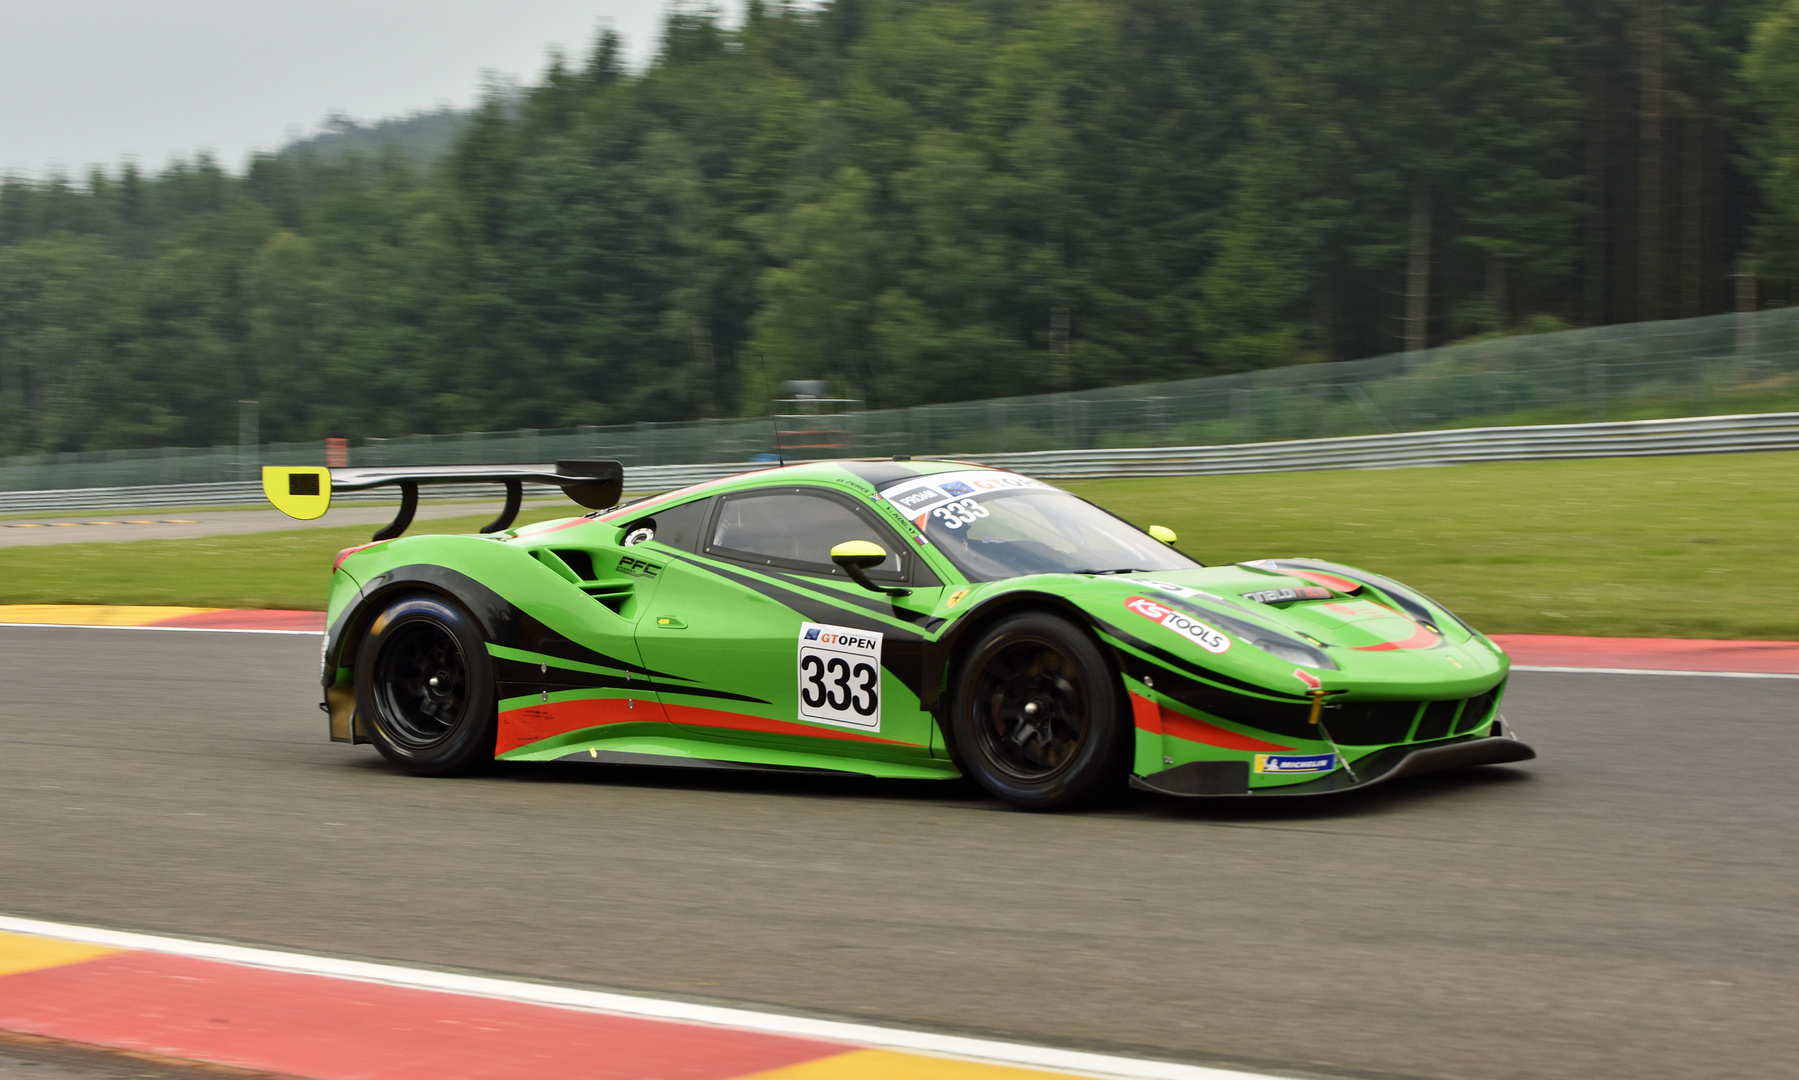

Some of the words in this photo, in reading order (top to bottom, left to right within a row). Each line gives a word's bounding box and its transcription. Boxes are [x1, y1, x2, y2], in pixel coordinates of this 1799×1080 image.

[932, 498, 990, 529] 333
[619, 556, 662, 576] PFC
[1169, 612, 1223, 648] TOOLS
[801, 655, 878, 716] 333
[1280, 760, 1328, 769] MICHELIN
